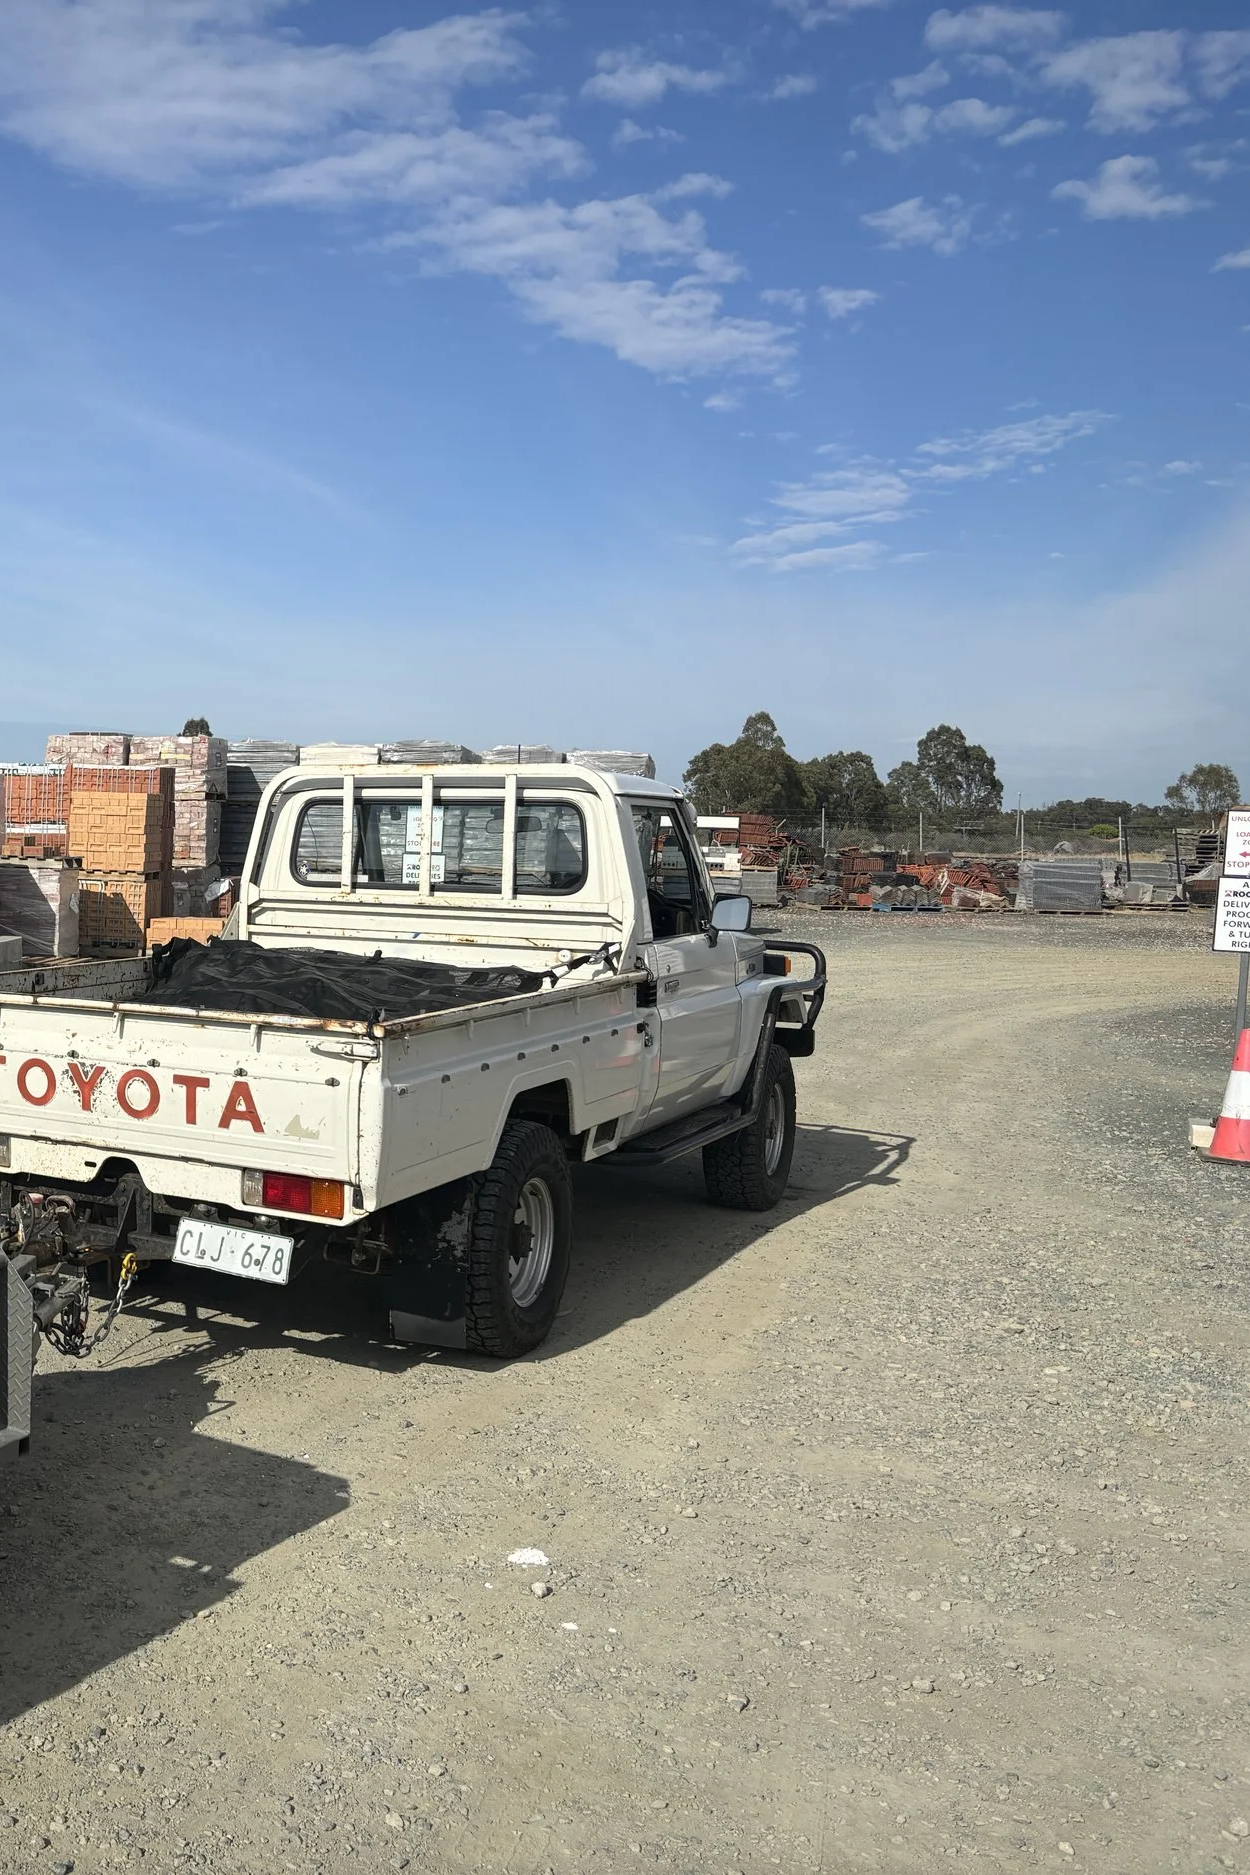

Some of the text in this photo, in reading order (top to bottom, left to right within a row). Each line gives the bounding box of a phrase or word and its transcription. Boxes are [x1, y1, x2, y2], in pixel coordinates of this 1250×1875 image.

[1229, 930, 1235, 938] &
[1231, 940, 1250, 949] RIG
[226, 1229, 246, 1239] VIC
